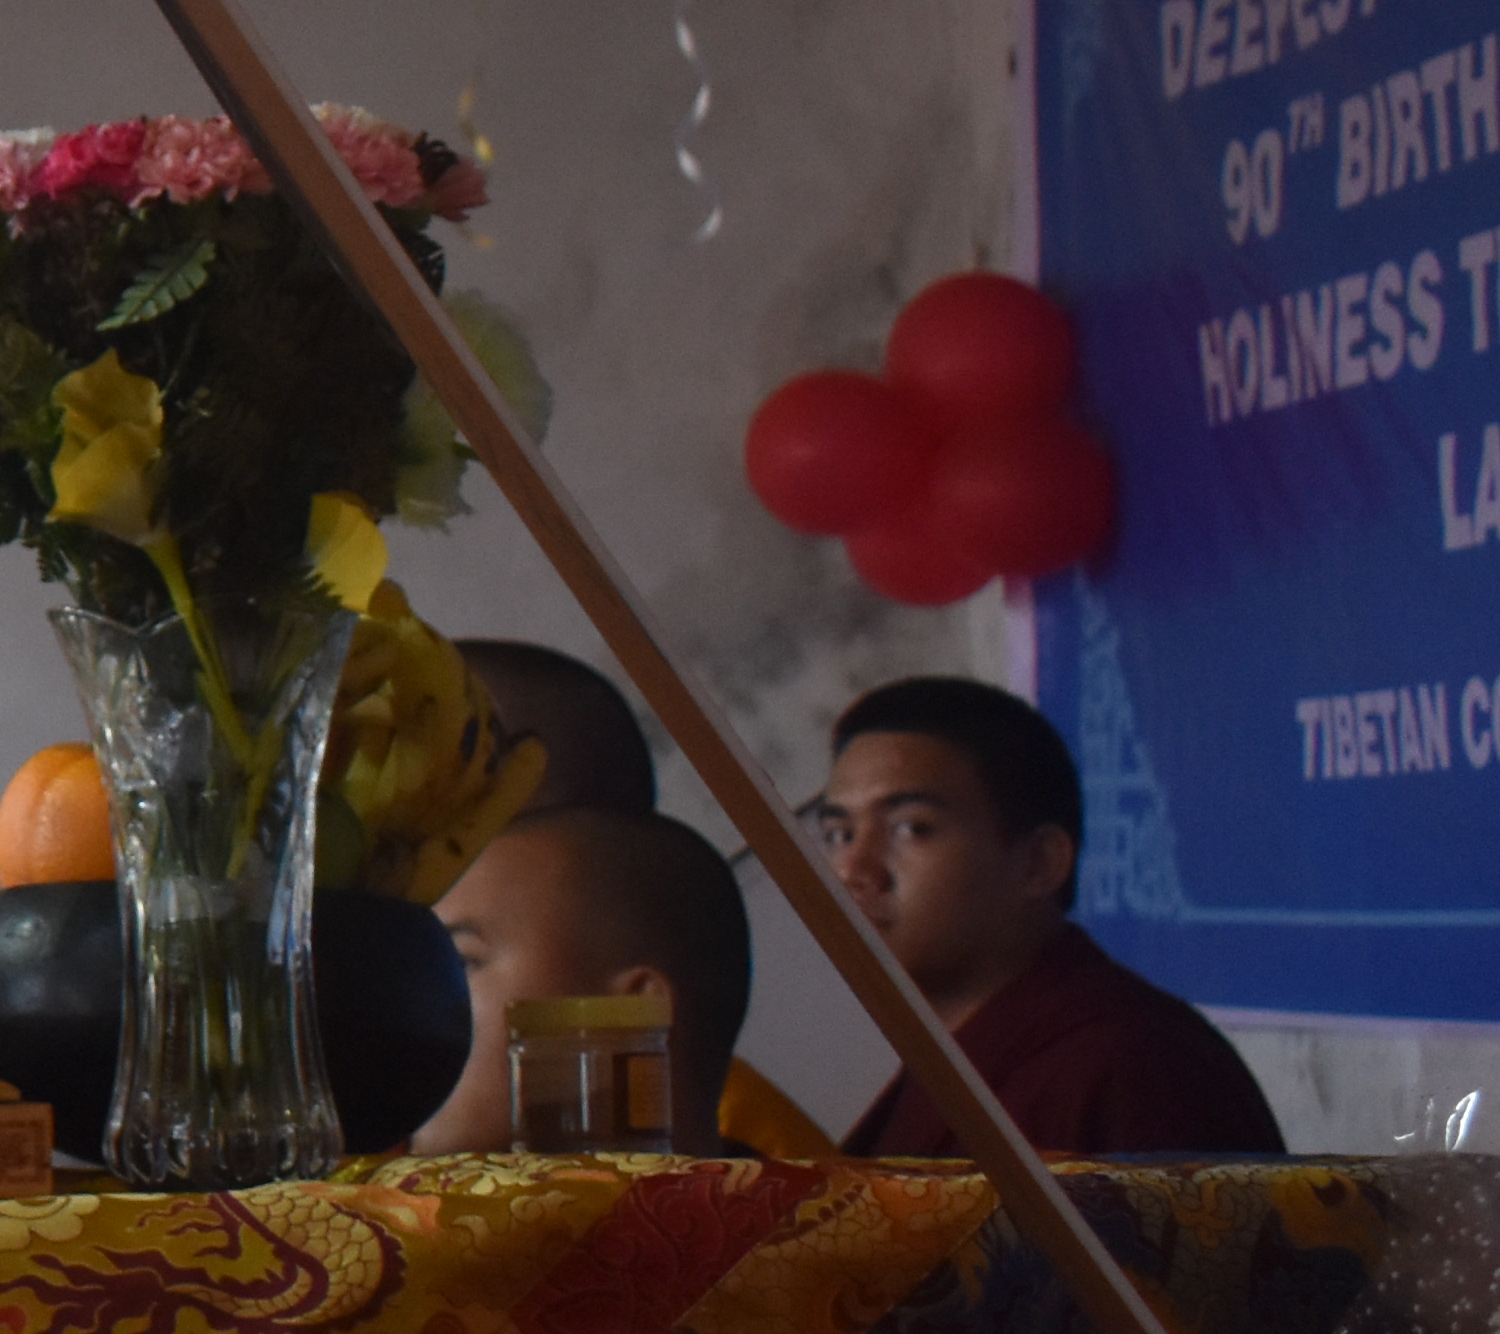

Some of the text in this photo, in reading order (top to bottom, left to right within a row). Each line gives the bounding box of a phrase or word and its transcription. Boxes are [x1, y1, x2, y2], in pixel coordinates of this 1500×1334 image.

[1336, 33, 1499, 210] BIRTH
[1201, 227, 1500, 428] HOLINESS T
[1296, 675, 1500, 782] TIBETAN C
